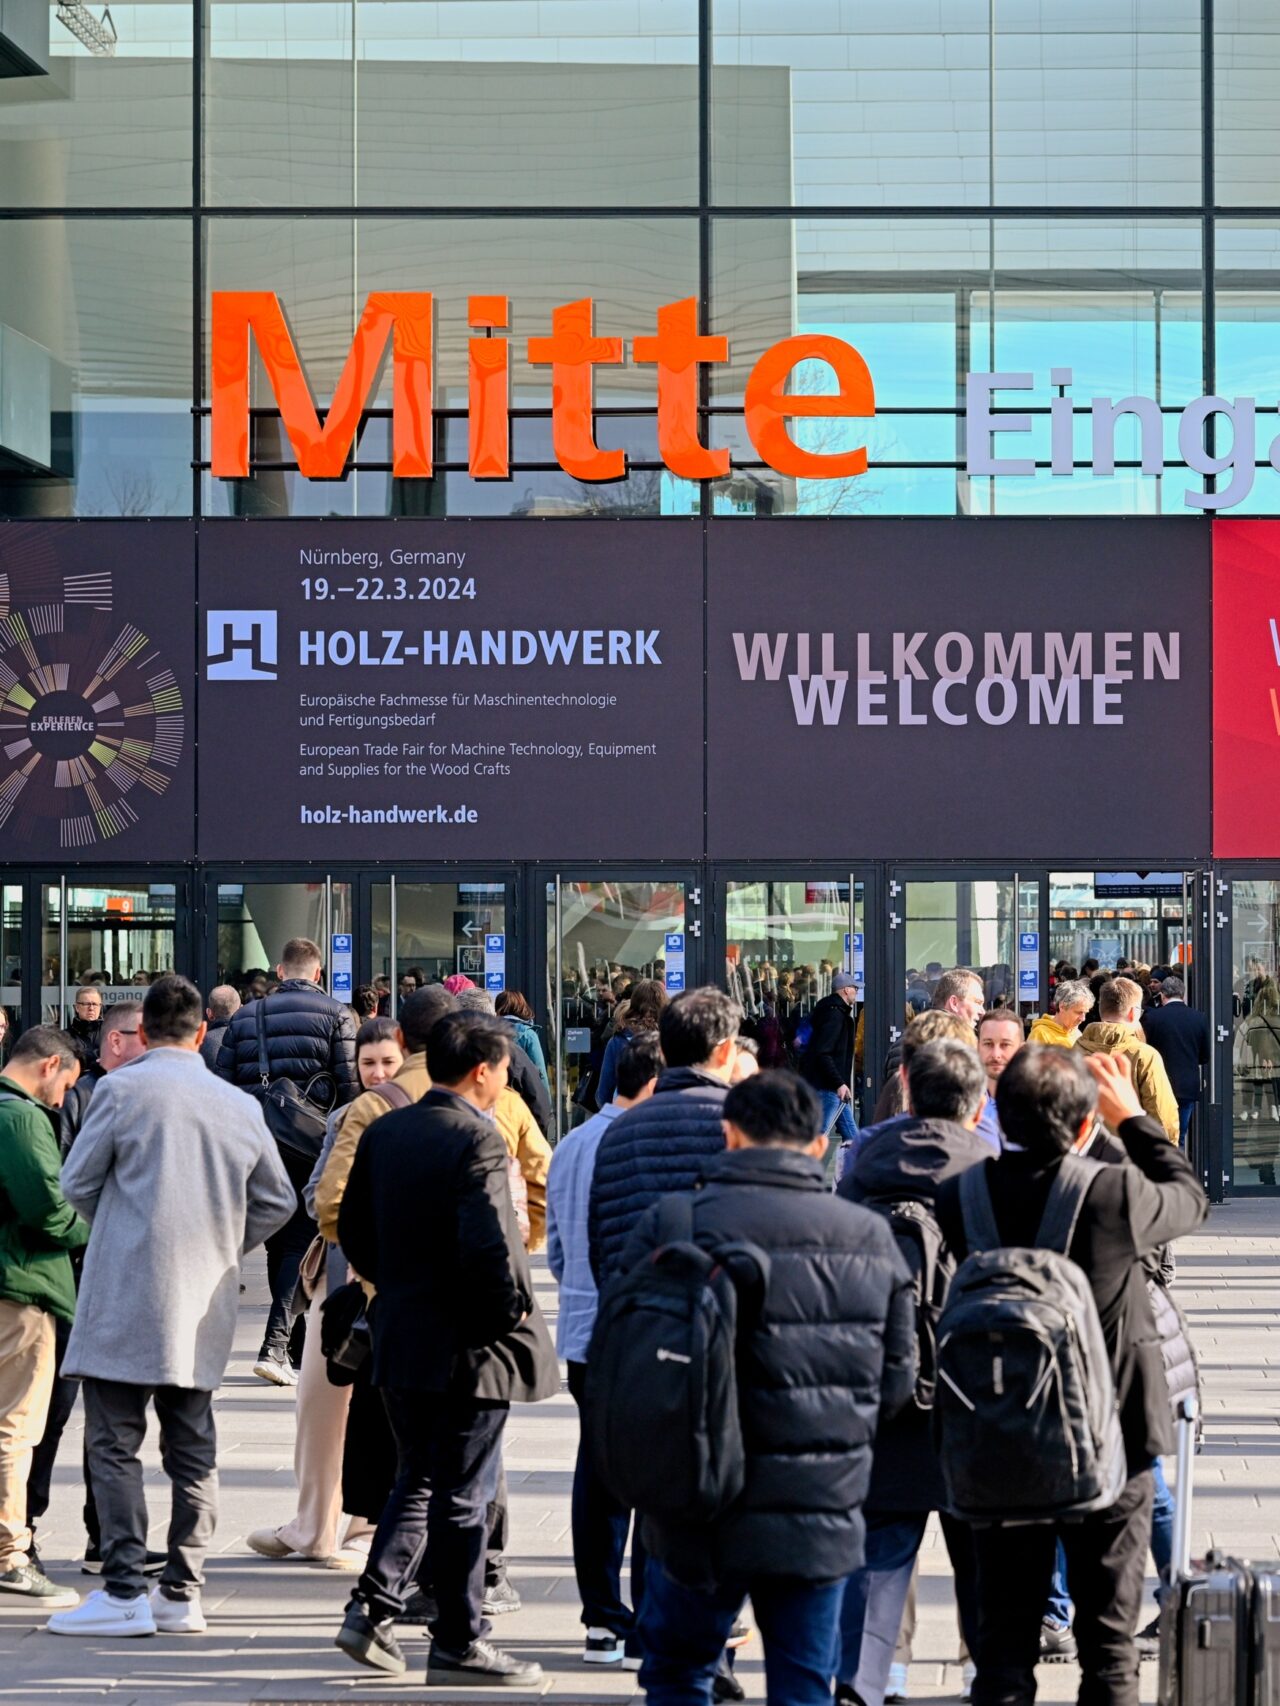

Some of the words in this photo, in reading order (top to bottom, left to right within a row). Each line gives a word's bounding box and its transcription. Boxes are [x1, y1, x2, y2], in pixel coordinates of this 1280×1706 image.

[211, 291, 875, 481] Mitte
[300, 548, 383, 569] Nürnberg,
[391, 548, 466, 569] Germany
[300, 629, 663, 666] HOLZ-HANDWERK
[732, 632, 1180, 681] WILLKOMMEN
[300, 693, 376, 709] Europäische
[381, 693, 449, 706] Fachmesse
[452, 693, 470, 706] für
[474, 693, 617, 709] Maschinentechnologie
[787, 674, 1124, 726] WELCOME
[31, 722, 94, 731] EXPERIENCE
[300, 713, 324, 727] und
[329, 713, 436, 729] Fertigungsbedarf
[300, 743, 360, 759] European
[364, 743, 399, 756] Trade
[403, 743, 425, 756] Fair
[428, 743, 448, 756] for
[452, 743, 506, 756] Machine
[510, 743, 584, 759] Technology,
[589, 743, 657, 759] Equipment
[300, 763, 324, 776] and
[328, 763, 380, 779] Supplies
[384, 763, 403, 776] for
[406, 763, 427, 776] the
[430, 763, 470, 776] Wood
[474, 763, 511, 776] Crafts
[300, 805, 478, 824] holz-handwerk.de
